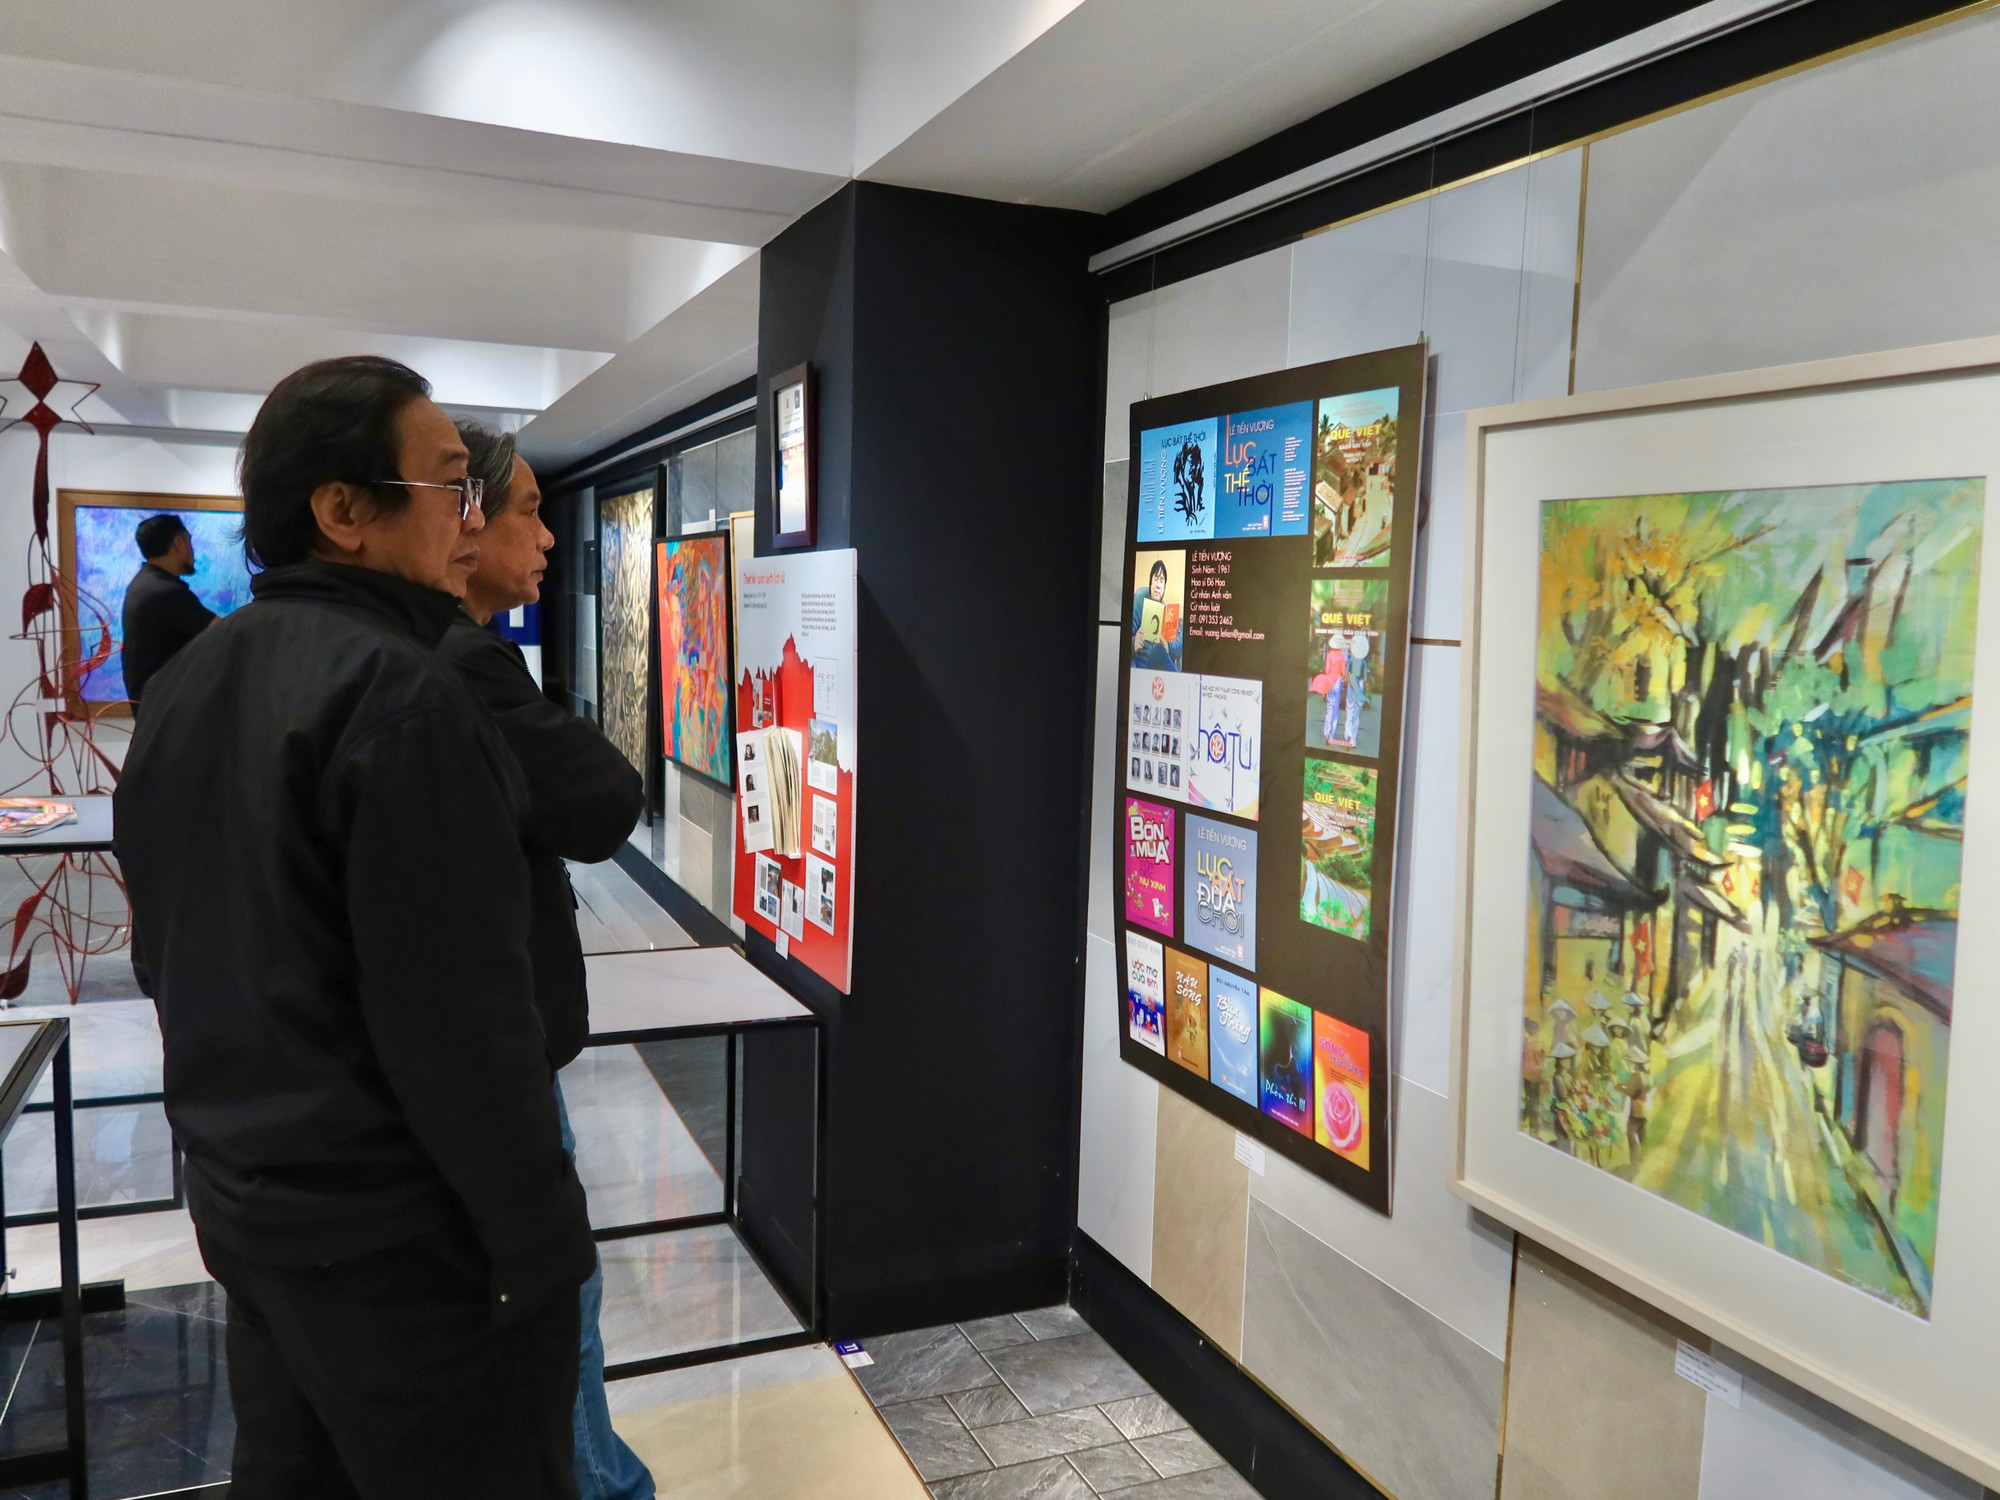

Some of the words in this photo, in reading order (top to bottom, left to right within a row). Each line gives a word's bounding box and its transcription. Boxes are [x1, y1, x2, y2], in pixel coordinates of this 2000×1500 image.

[1225, 414, 1256, 468] LỤC
[1247, 449, 1277, 477] BÁT
[1224, 463, 1250, 494] THẾ
[1192, 565, 1202, 574] Sinh
[1218, 564, 1230, 574] 1961
[1130, 815, 1164, 841] BỐN
[1197, 850, 1233, 882] LỤC
[1150, 880, 1166, 892] XINH
[1212, 870, 1245, 904] BÁT
